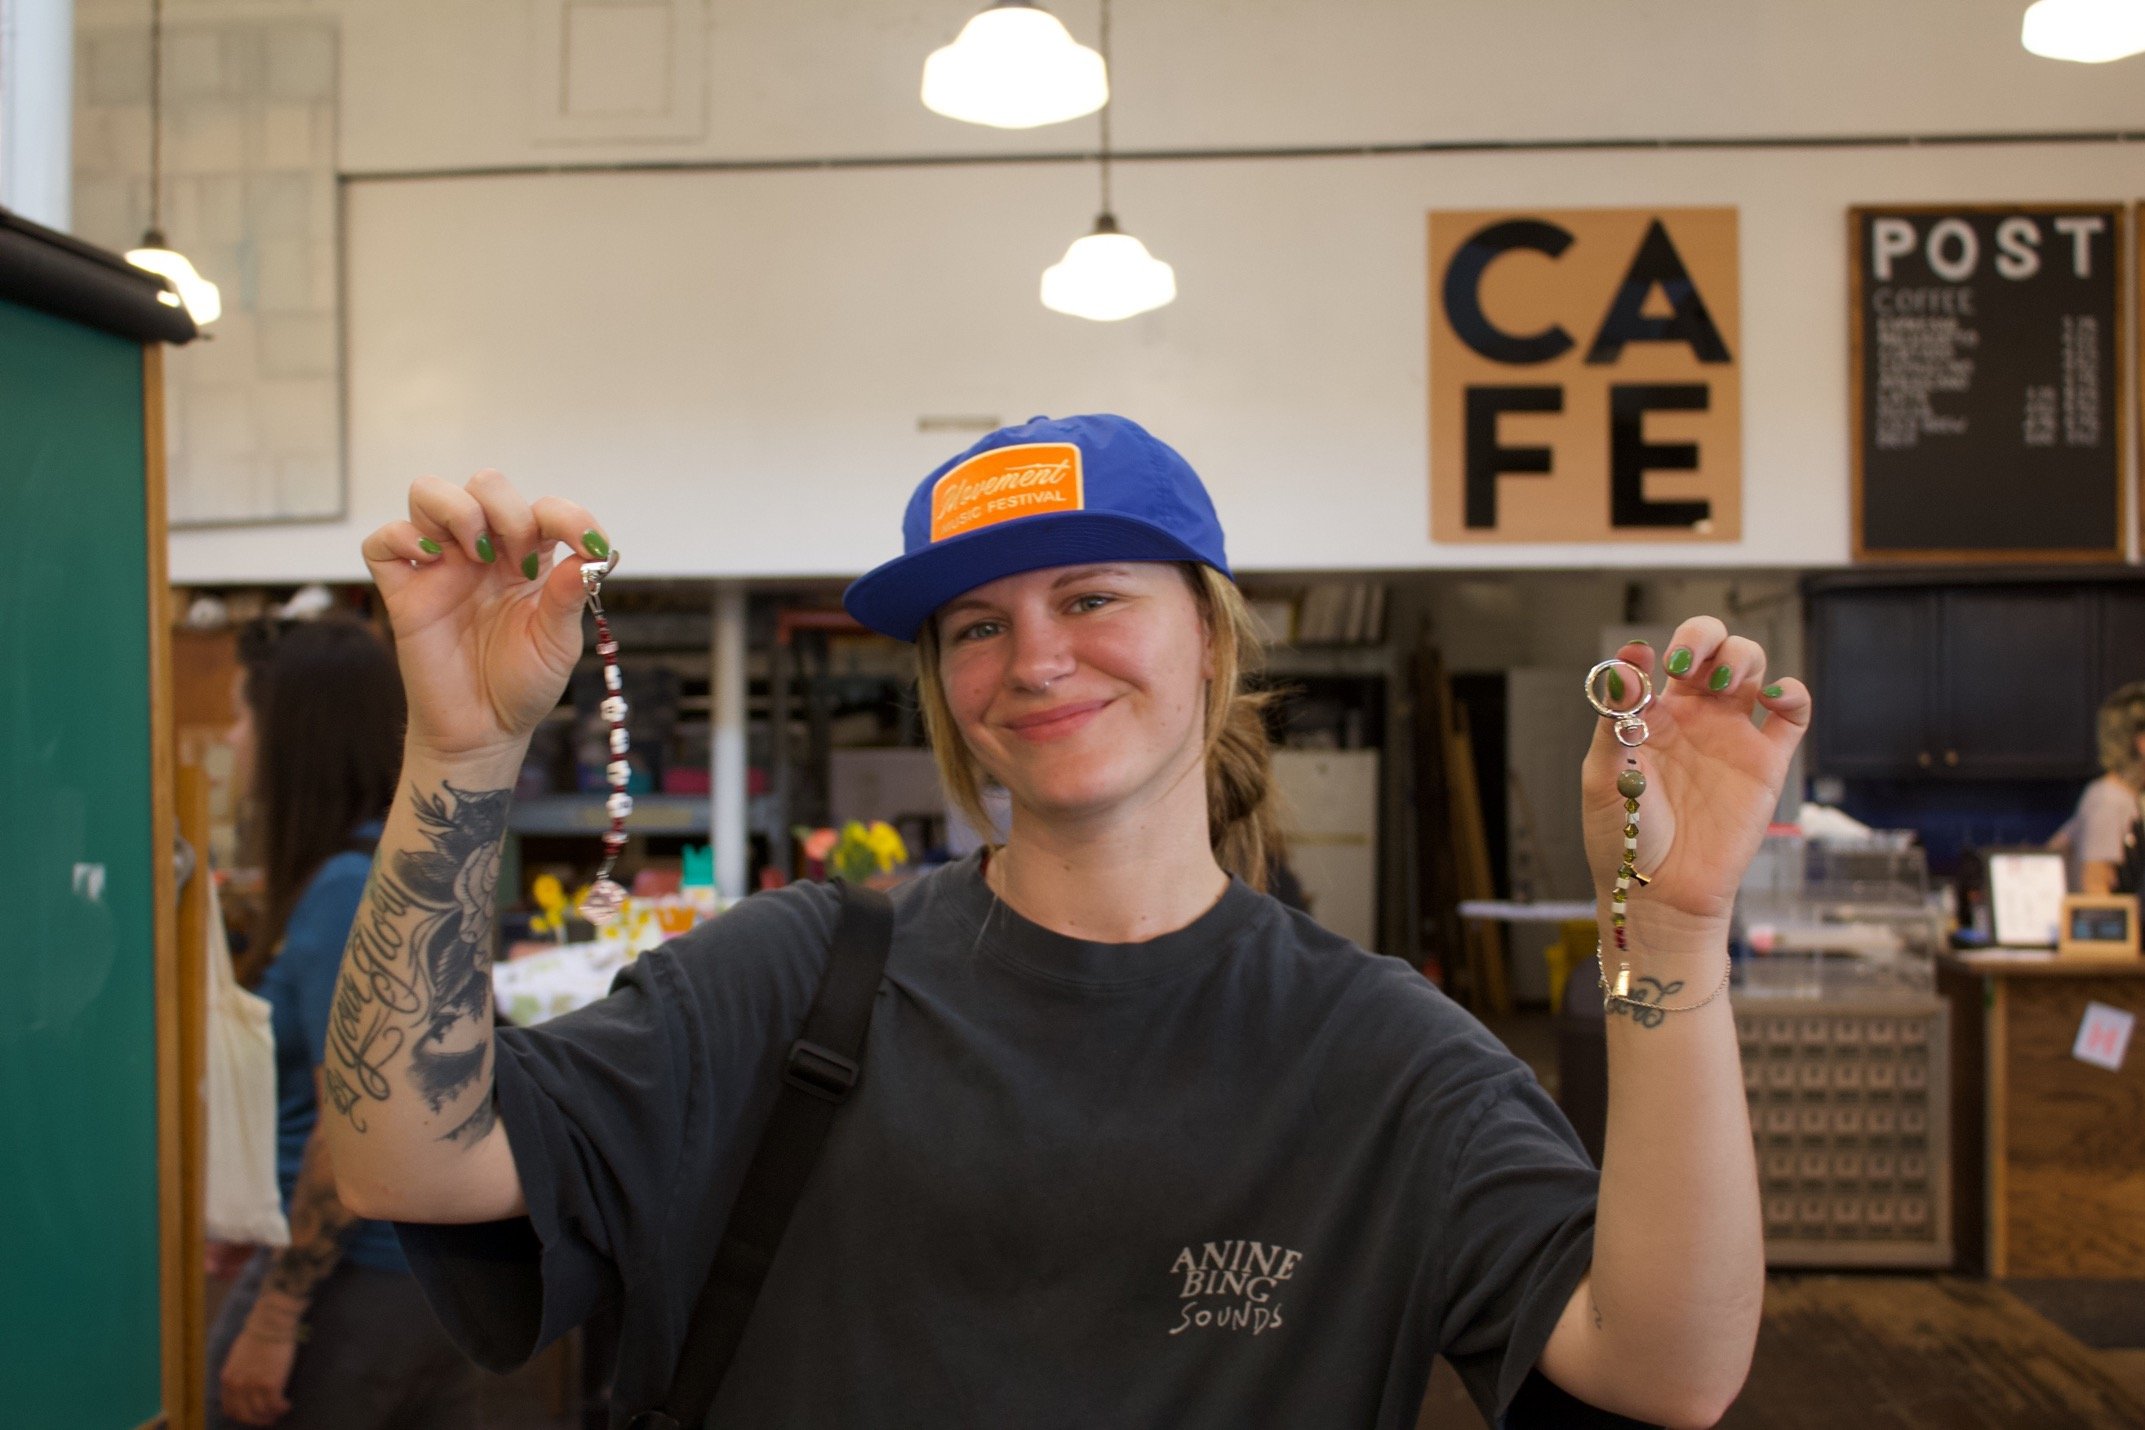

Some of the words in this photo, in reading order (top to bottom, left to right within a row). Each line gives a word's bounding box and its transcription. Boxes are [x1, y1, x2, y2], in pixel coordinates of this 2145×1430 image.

[1872, 217, 2104, 281] POST
[937, 459, 1071, 520] Movement
[940, 507, 983, 534] MUSIC
[986, 490, 1068, 513] FESTIVAL
[1169, 1239, 1304, 1280] ANINE
[1178, 1269, 1279, 1303] BING
[1168, 1300, 1284, 1336] SOUNDS
